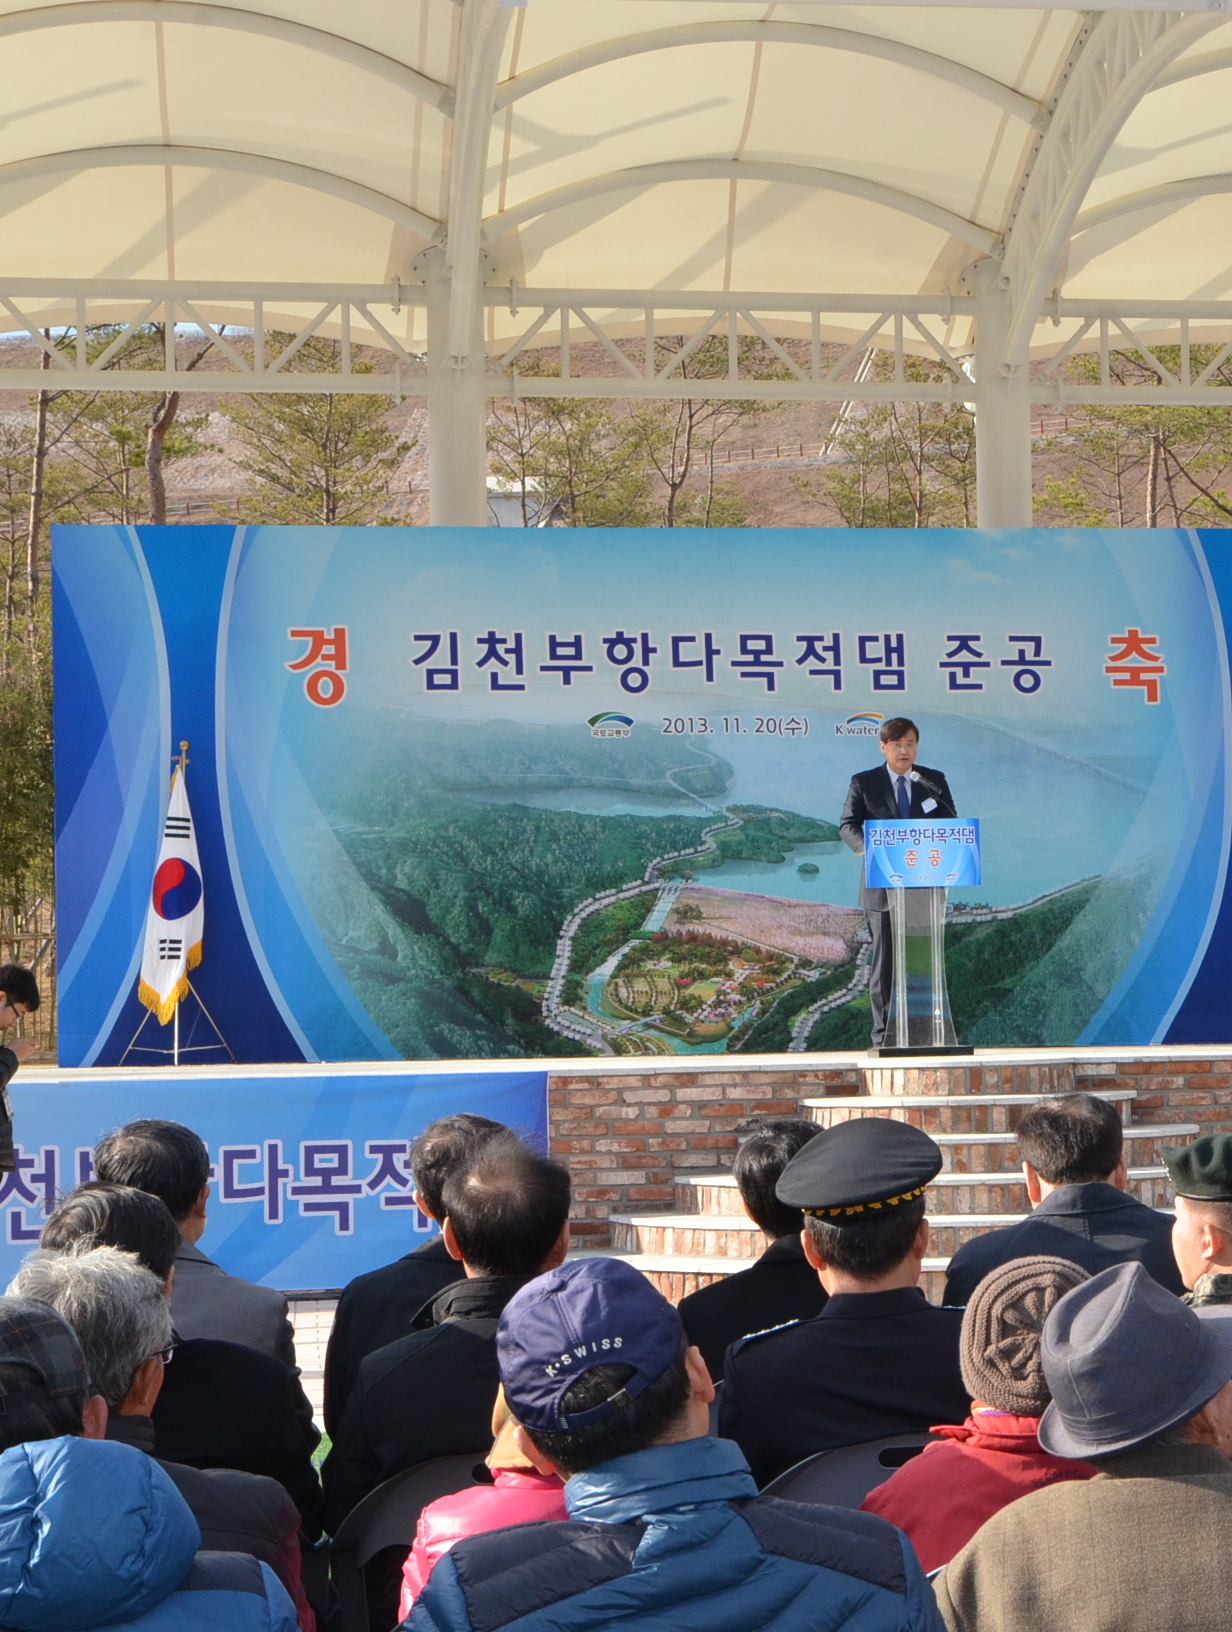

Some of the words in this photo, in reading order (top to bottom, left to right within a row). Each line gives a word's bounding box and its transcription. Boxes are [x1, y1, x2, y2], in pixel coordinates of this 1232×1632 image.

[287, 627, 349, 706] 경
[411, 631, 908, 694] 김천부항다목적댐
[938, 634, 1053, 694] 준공
[1104, 627, 1166, 704] 축
[661, 717, 714, 735] 2013.
[722, 717, 747, 734] 11.
[754, 716, 810, 737] 20(수)
[870, 827, 975, 846] 김천부항다목적댐
